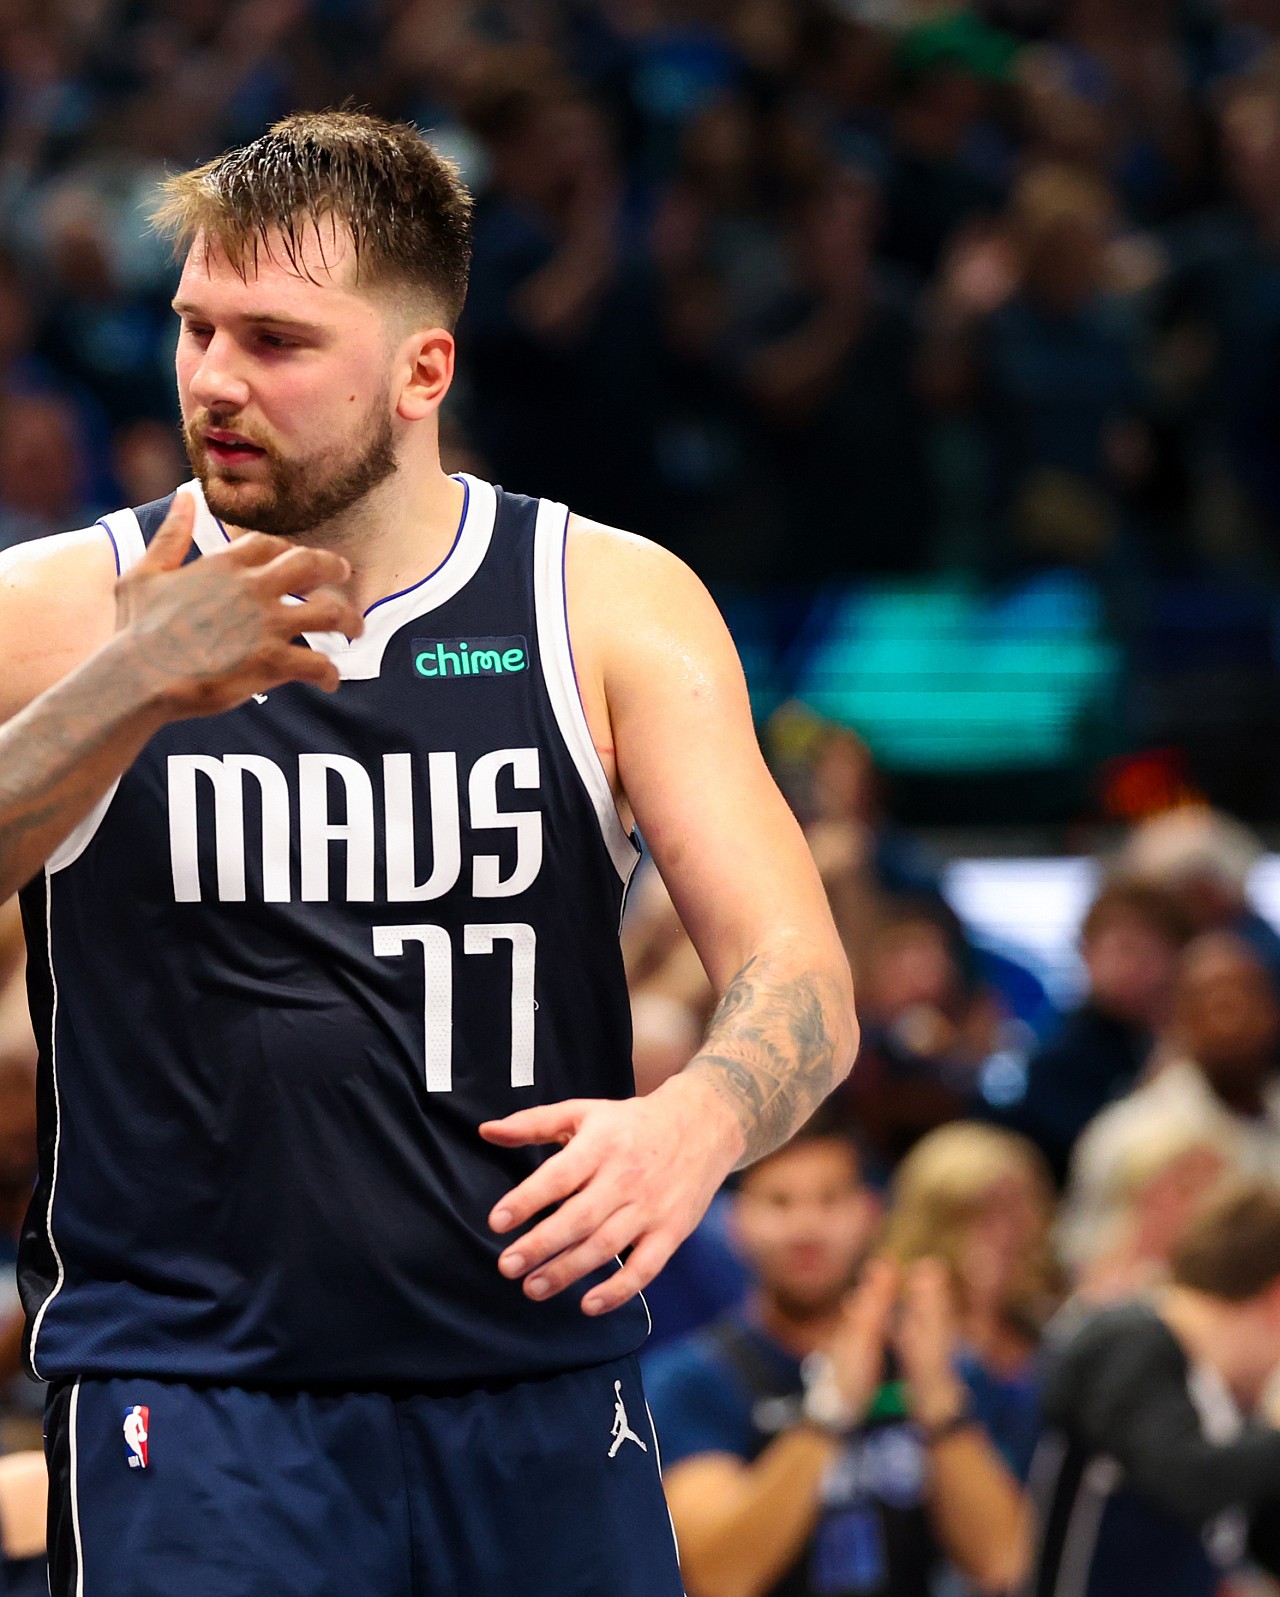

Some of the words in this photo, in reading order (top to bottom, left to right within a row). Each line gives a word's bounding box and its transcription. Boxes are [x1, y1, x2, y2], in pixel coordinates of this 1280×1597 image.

[415, 642, 525, 677] chime
[167, 748, 543, 903] MAVS
[372, 923, 537, 1093] 77
